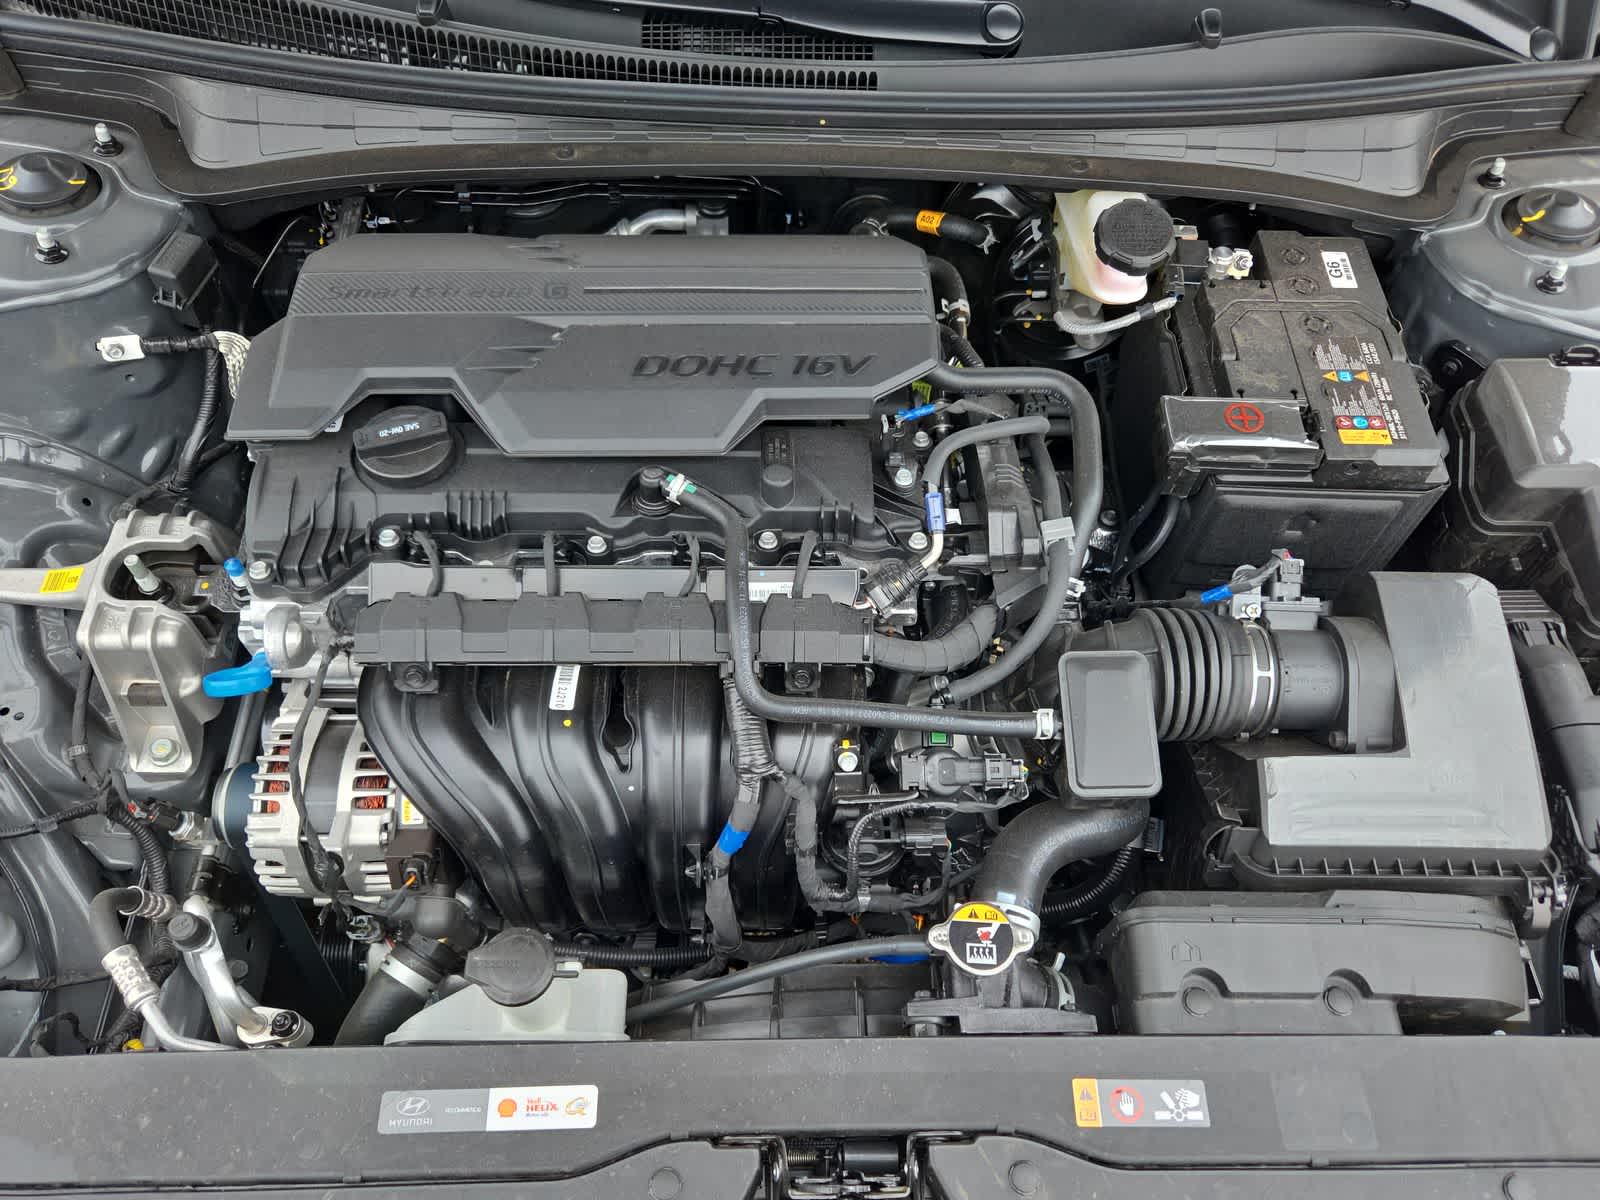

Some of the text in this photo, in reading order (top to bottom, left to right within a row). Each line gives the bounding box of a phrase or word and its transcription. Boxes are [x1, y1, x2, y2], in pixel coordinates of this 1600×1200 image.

[1325, 261, 1343, 279] G6
[631, 353, 878, 377] DOHC 16V
[404, 421, 420, 431] SAE
[525, 1102, 559, 1112] HELIX
[388, 1117, 433, 1129] HYUNDAI
